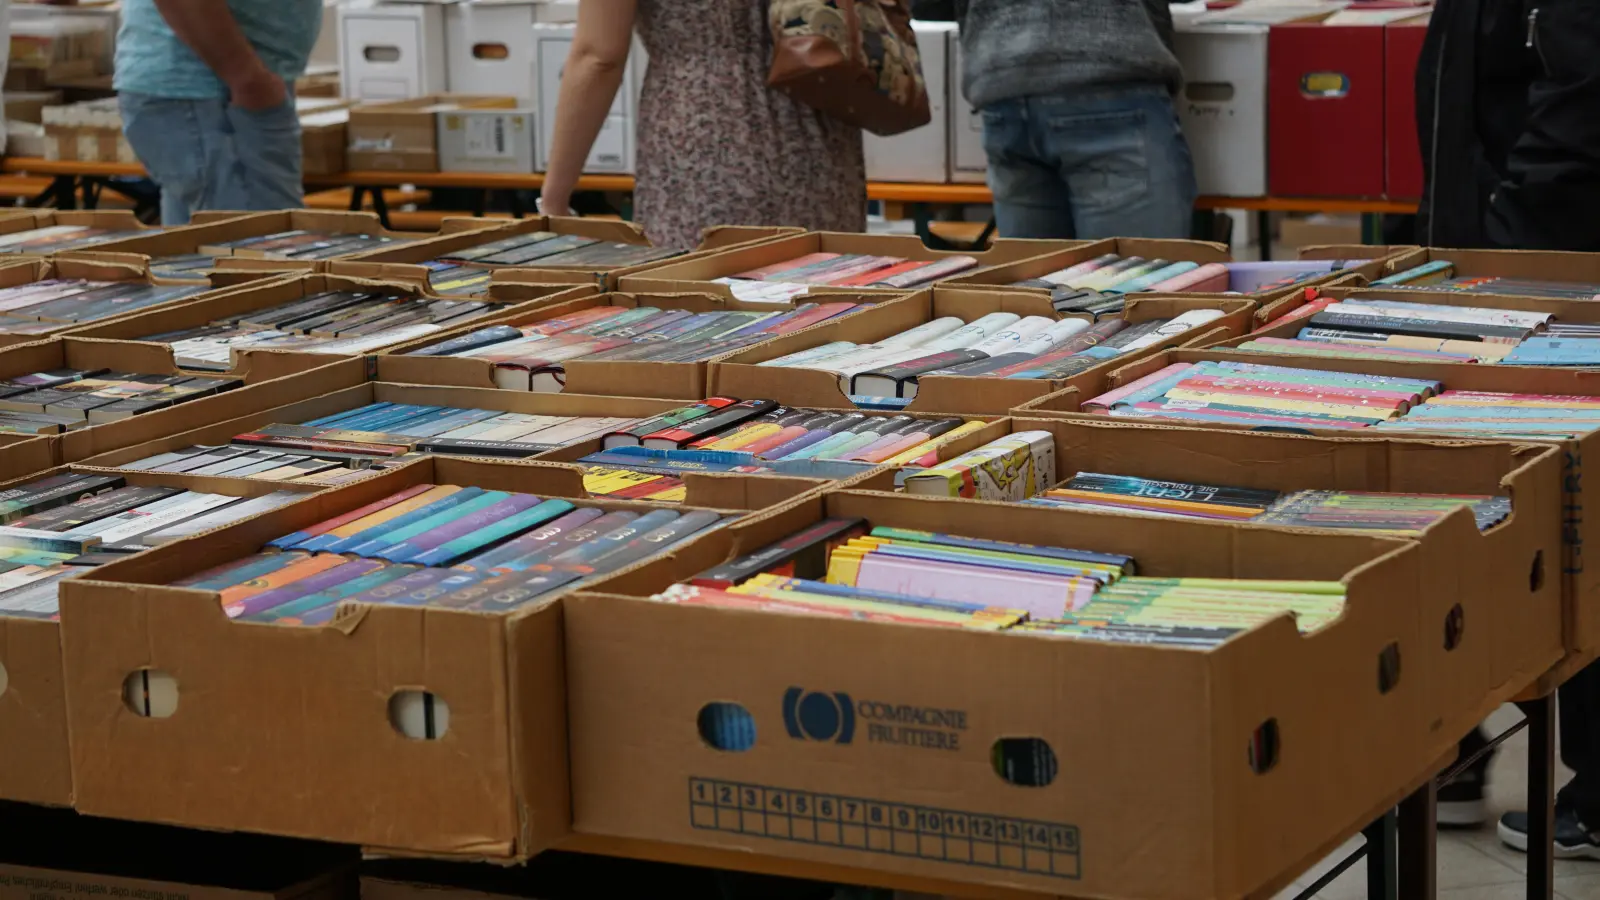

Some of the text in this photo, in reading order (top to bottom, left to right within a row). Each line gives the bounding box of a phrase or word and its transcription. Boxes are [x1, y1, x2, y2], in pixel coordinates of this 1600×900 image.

[1198, 485, 1219, 493] DIE
[858, 700, 967, 731] COMPAGNIE
[868, 723, 960, 750] FRUITIERE
[697, 784, 1075, 848] 1 2 3 4 5 6 7 8 9 10 11 12 13 14 15
[110, 887, 130, 898] oder
